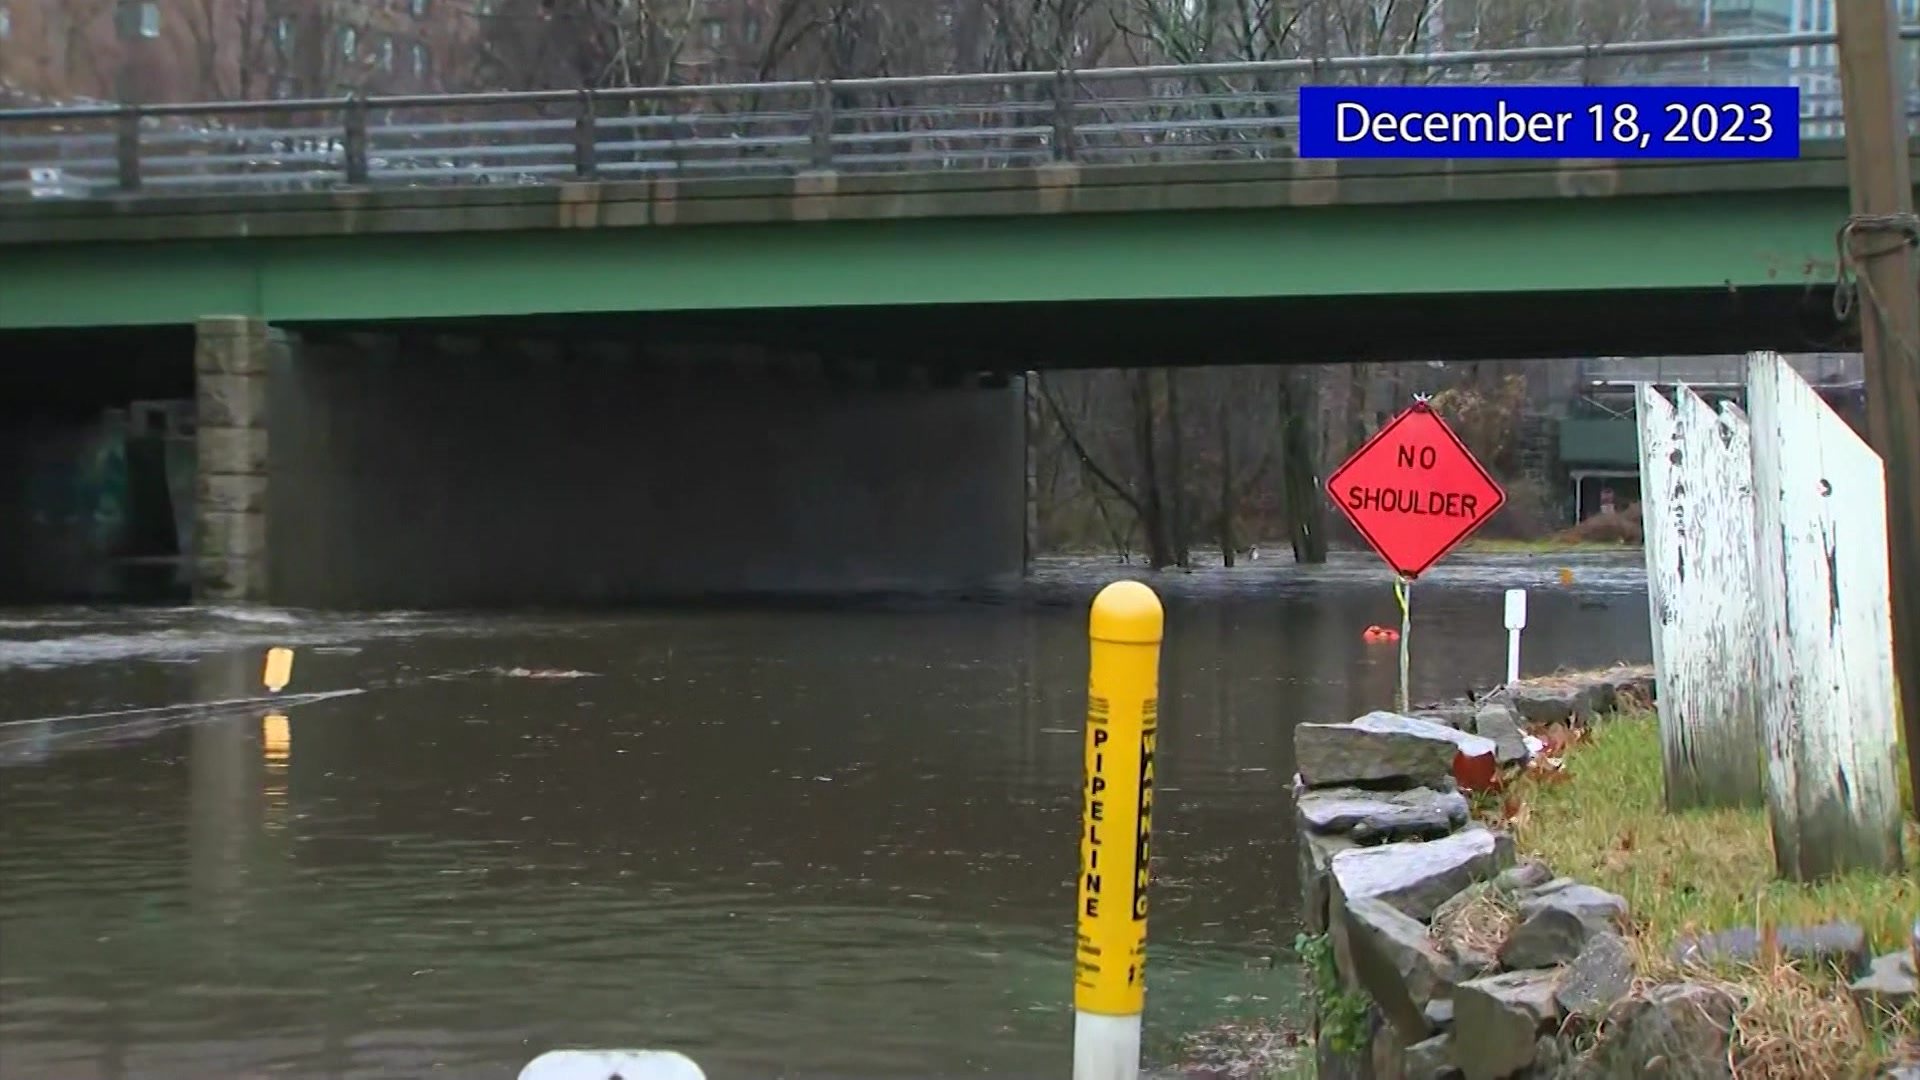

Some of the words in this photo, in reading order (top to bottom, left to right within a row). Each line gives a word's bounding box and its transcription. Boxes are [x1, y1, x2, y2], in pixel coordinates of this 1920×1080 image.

[1397, 445, 1437, 470] NO
[1348, 486, 1478, 519] SHOULDER
[1086, 728, 1108, 918] PIPELINE
